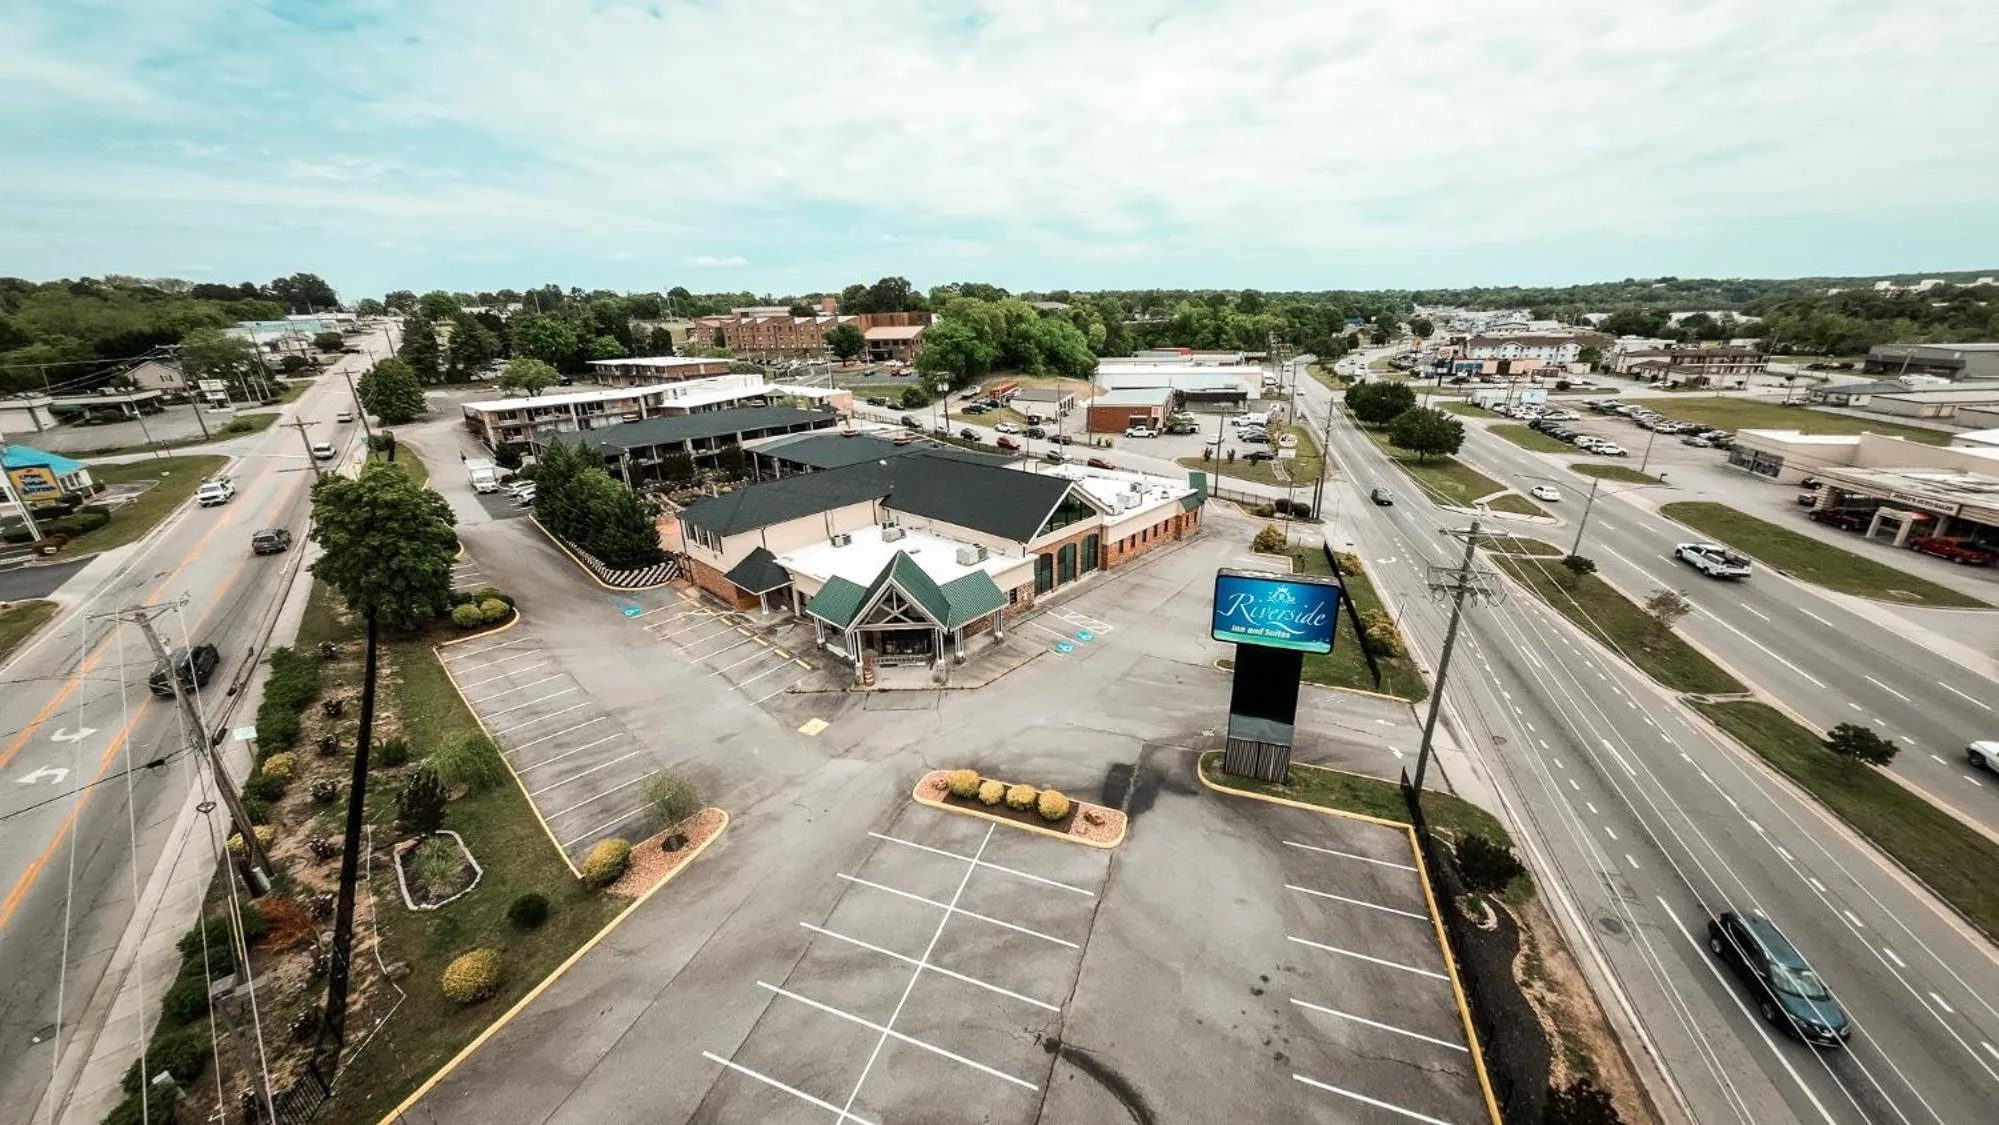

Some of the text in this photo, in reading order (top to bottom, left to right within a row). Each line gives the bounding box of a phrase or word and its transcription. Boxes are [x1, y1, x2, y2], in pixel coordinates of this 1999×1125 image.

[1216, 592, 1326, 626] Riverside
[1231, 625, 1245, 633] Inn
[1264, 629, 1291, 638] Suites
